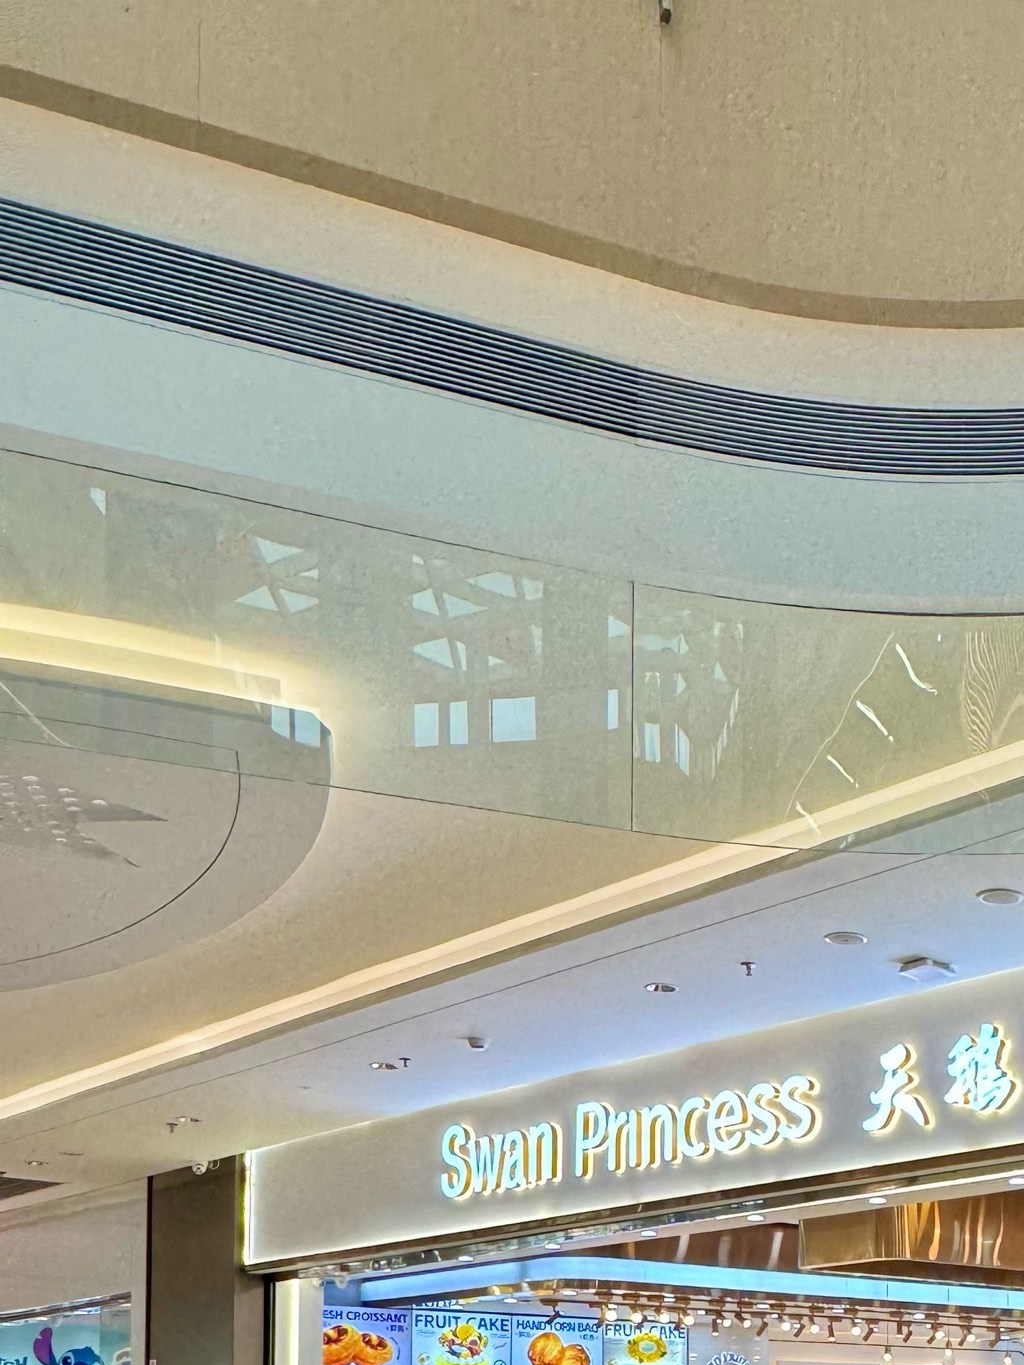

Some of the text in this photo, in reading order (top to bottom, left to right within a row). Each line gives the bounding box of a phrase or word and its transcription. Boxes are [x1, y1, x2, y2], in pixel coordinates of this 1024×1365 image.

[441, 1074, 820, 1198] Swan Princess
[346, 1311, 408, 1324] CROISSANT
[415, 1314, 461, 1329] FRUIT
